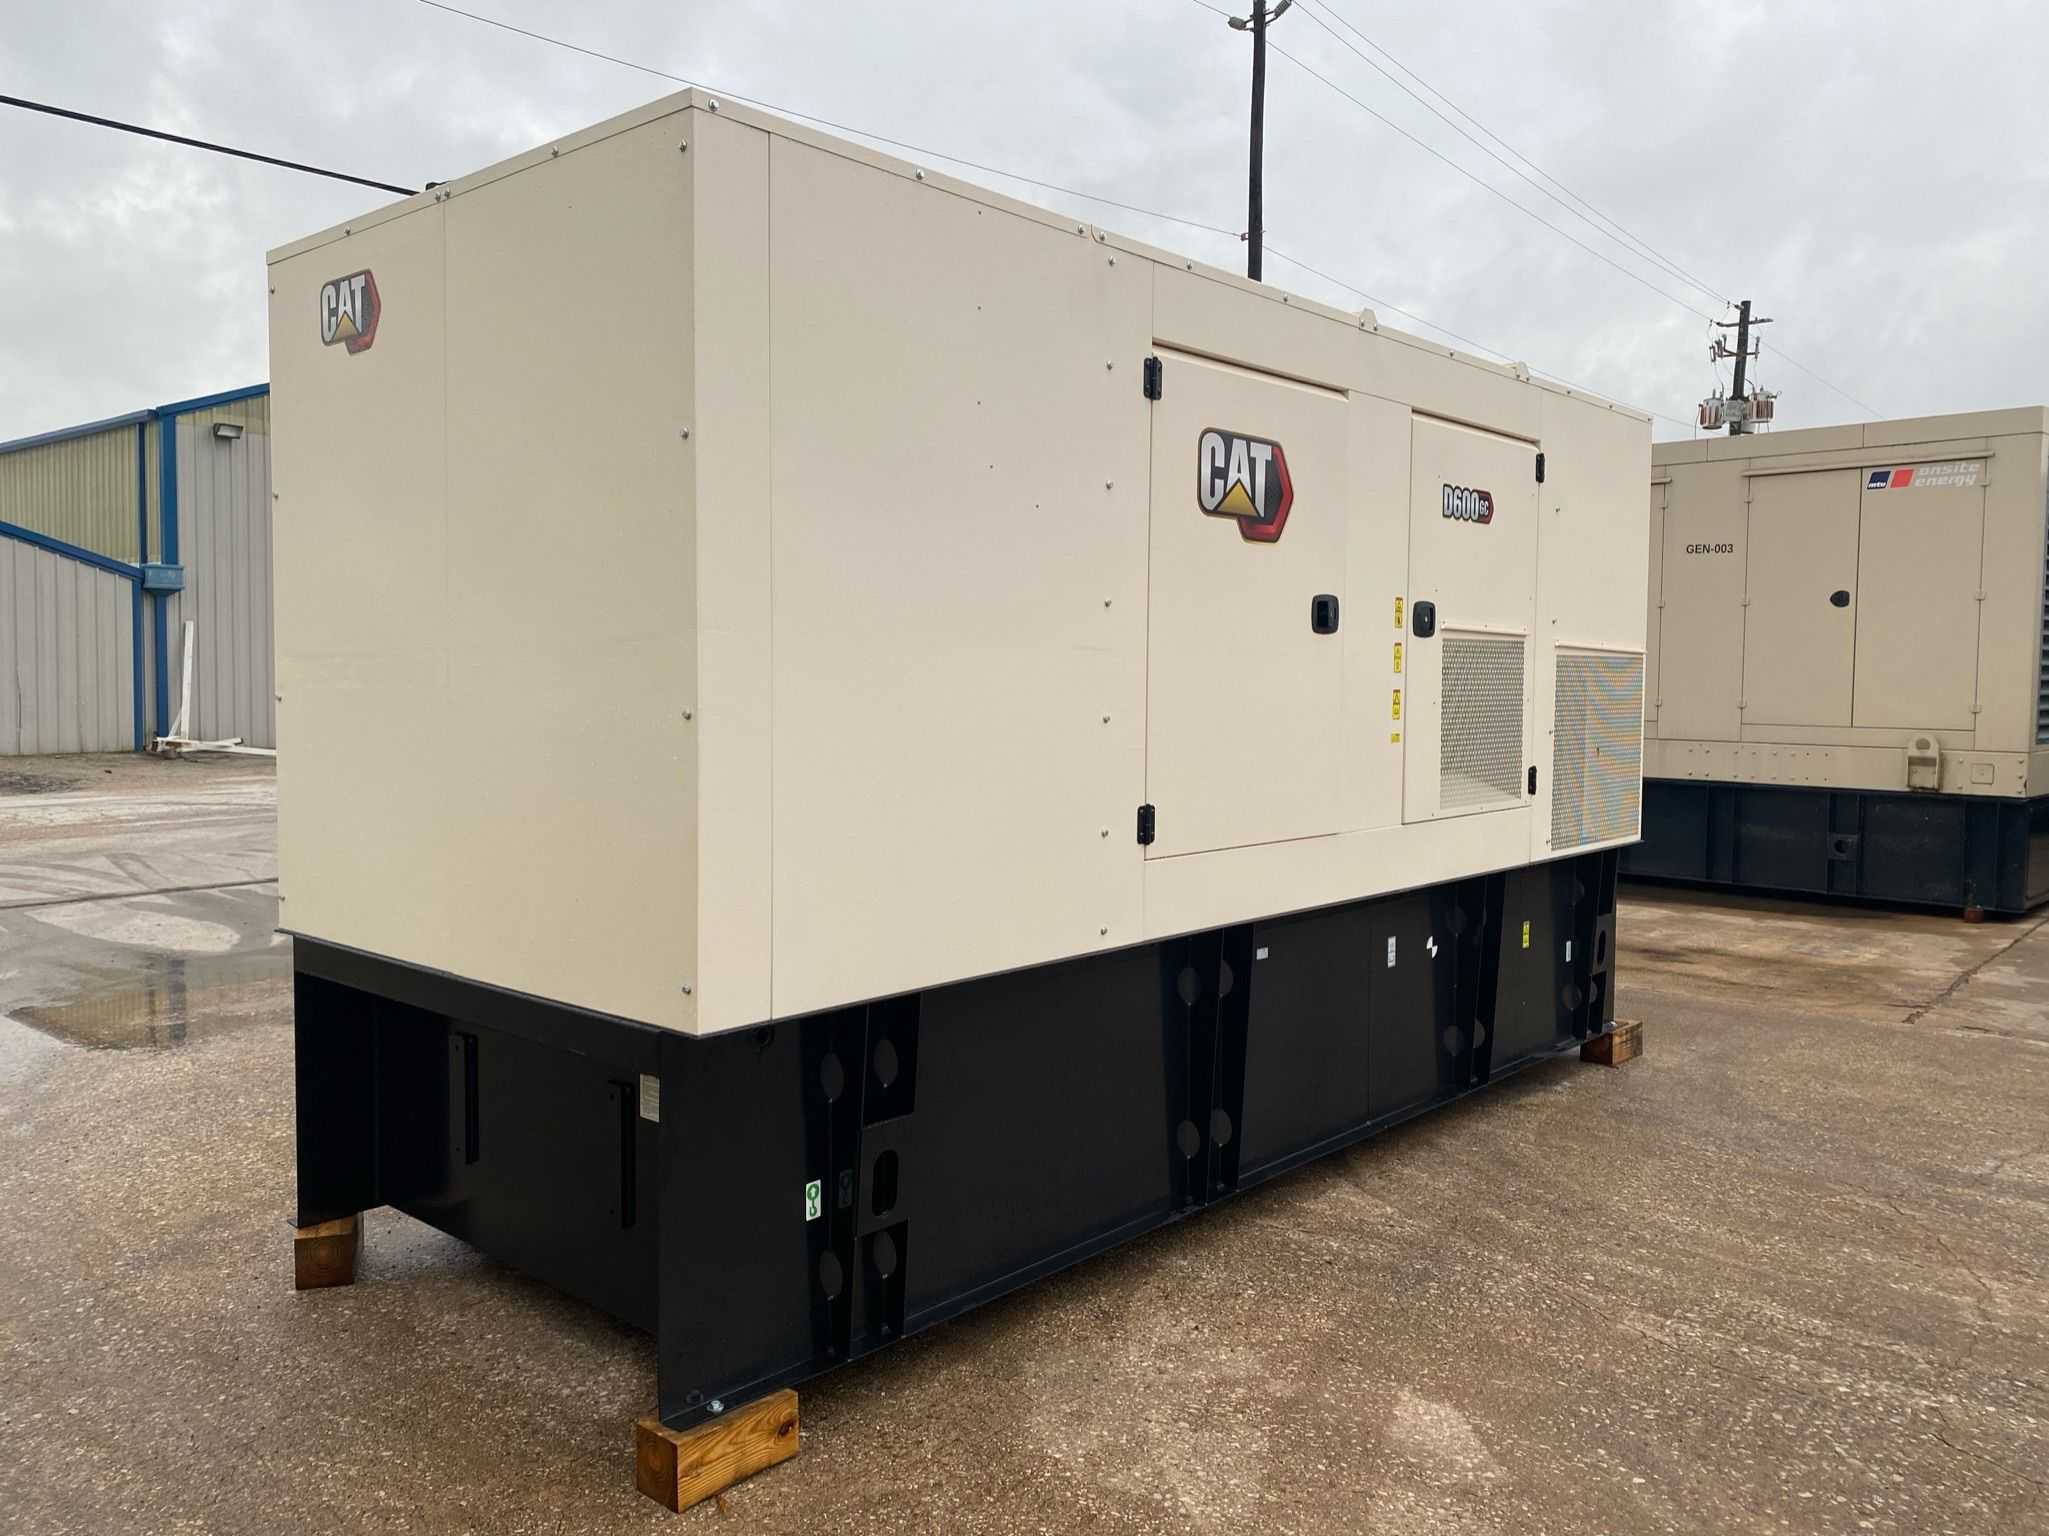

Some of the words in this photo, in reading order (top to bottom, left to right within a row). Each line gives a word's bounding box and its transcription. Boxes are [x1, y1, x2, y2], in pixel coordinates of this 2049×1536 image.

[321, 273, 366, 343] CAT
[1200, 431, 1272, 518] CAT
[1914, 474, 1977, 487] energy
[1686, 543, 1733, 554] GEN-003
